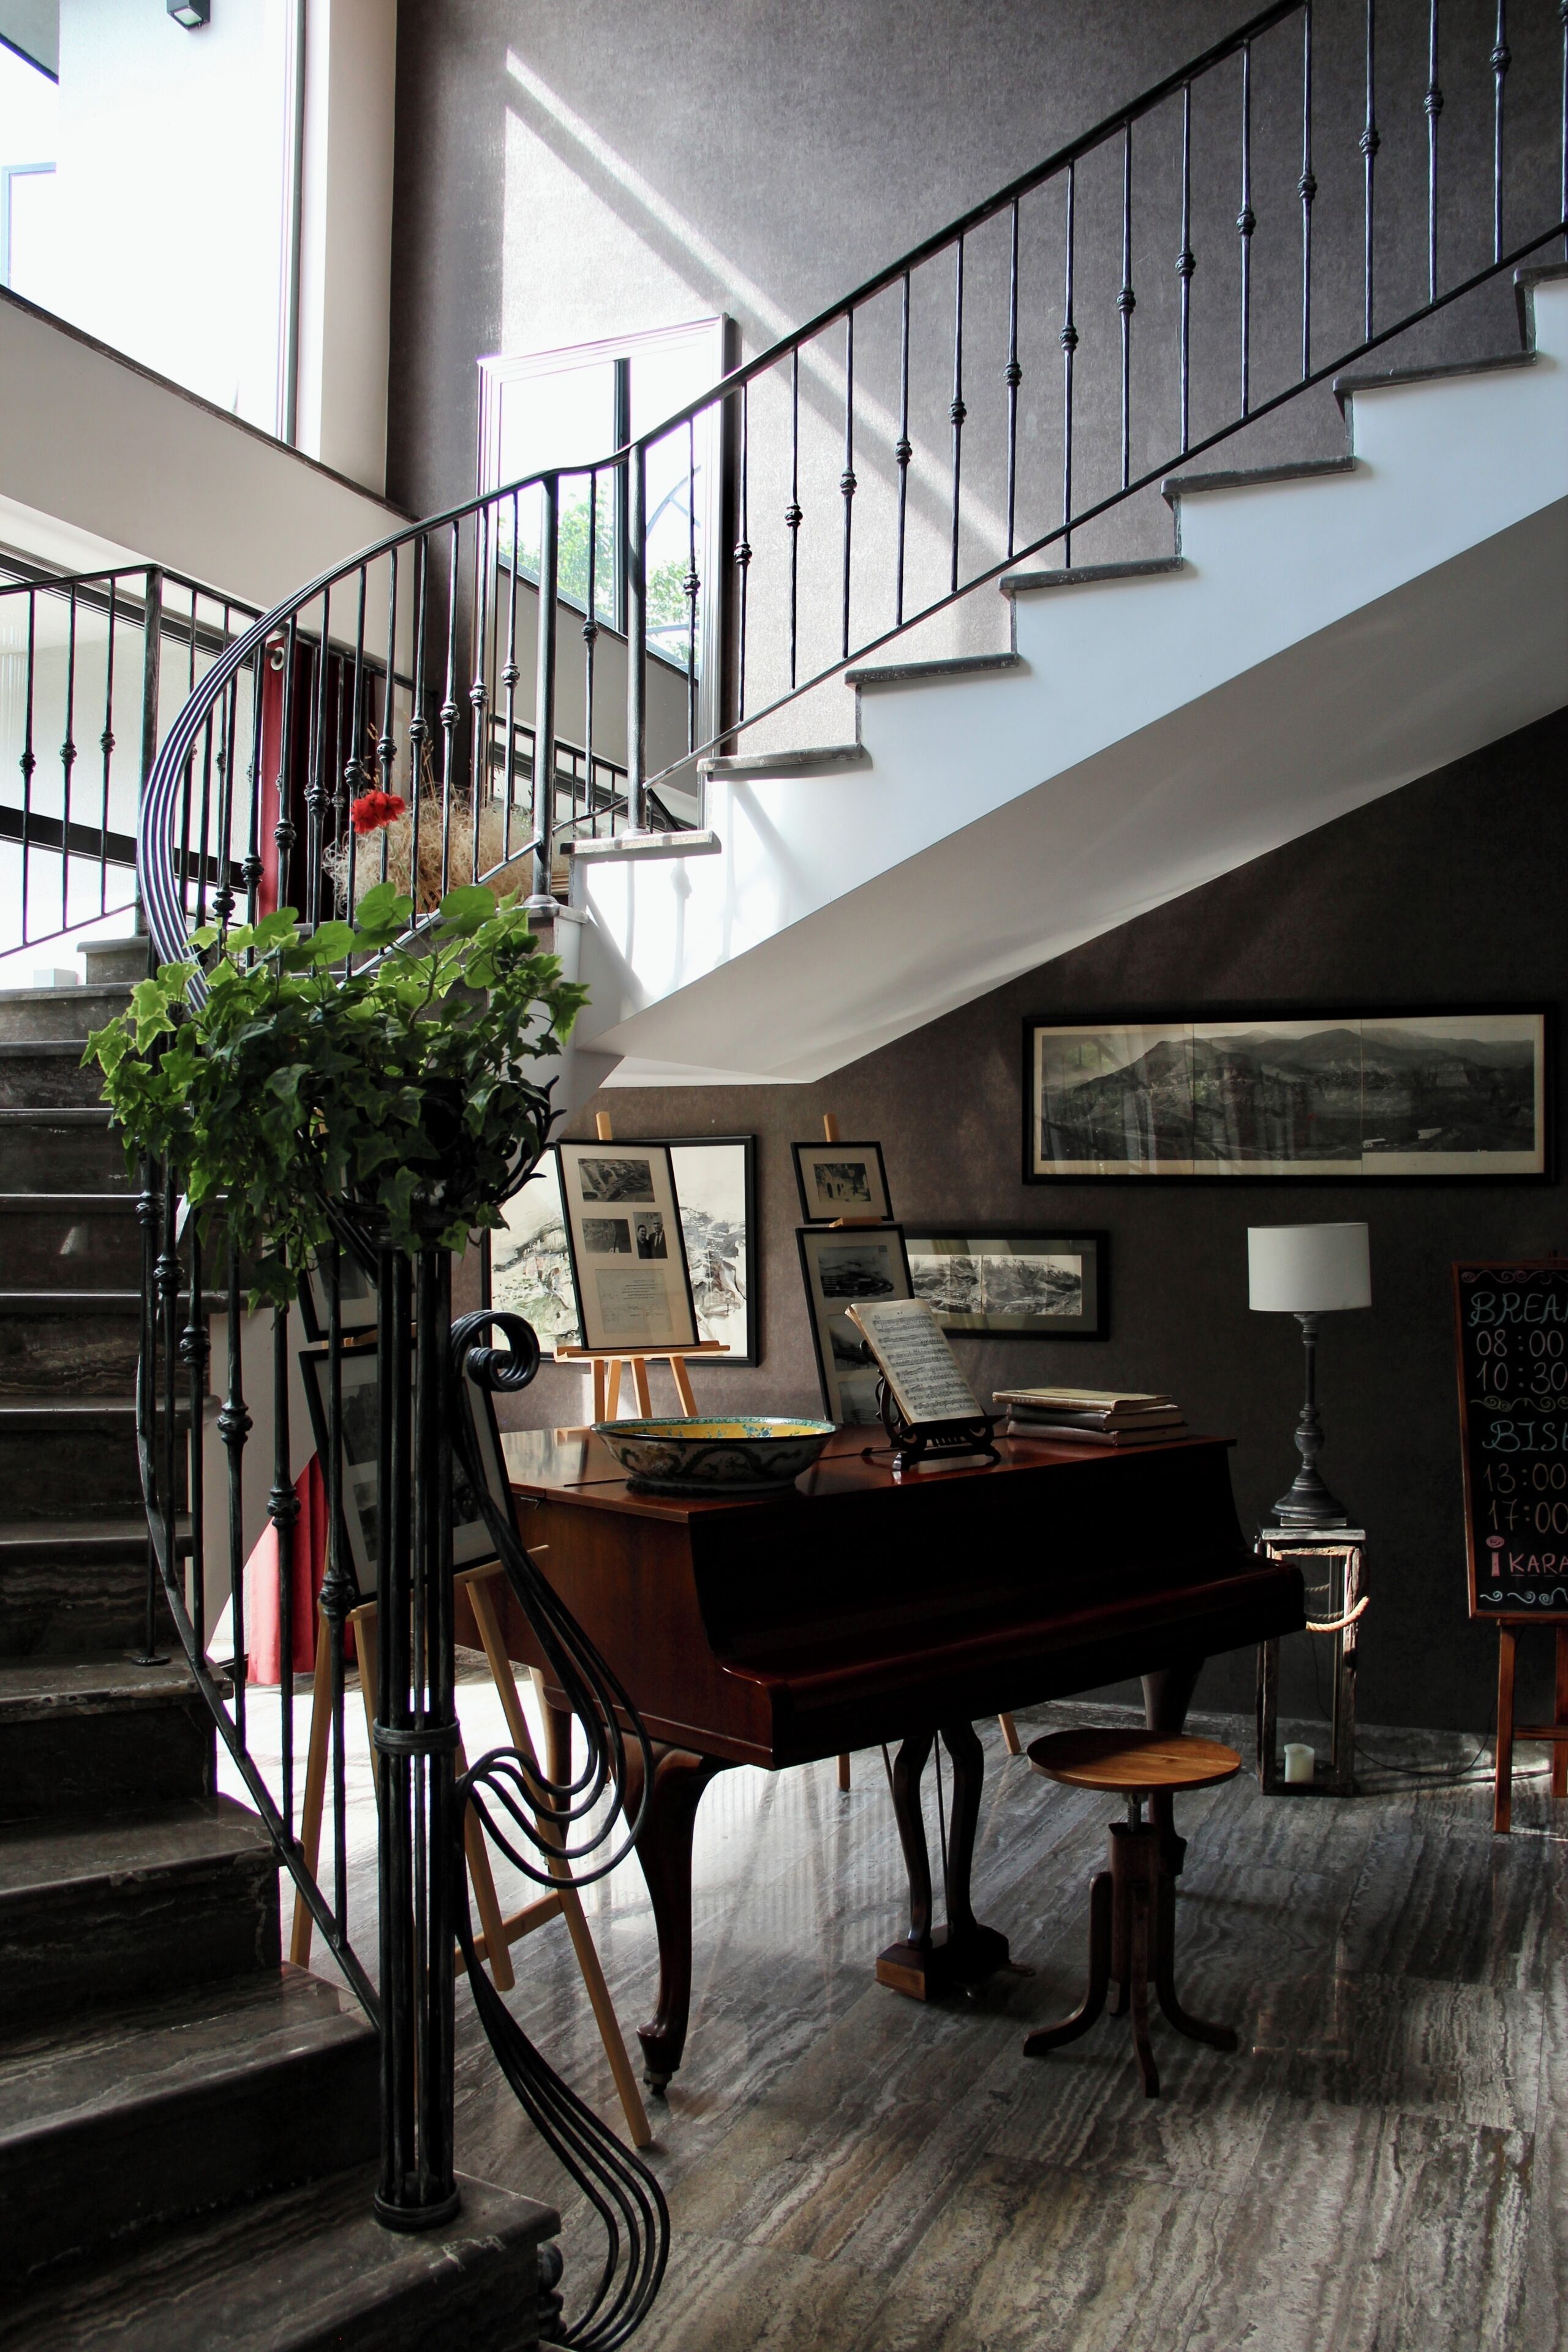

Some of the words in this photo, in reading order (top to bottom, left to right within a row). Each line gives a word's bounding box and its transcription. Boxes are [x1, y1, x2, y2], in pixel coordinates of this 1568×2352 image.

[1468, 1291, 1568, 1327] BREA
[1476, 1329, 1564, 1357] 08:00
[1476, 1360, 1568, 1395] 10:30
[1483, 1463, 1567, 1493] 13:00
[1488, 1499, 1568, 1534] 17:00
